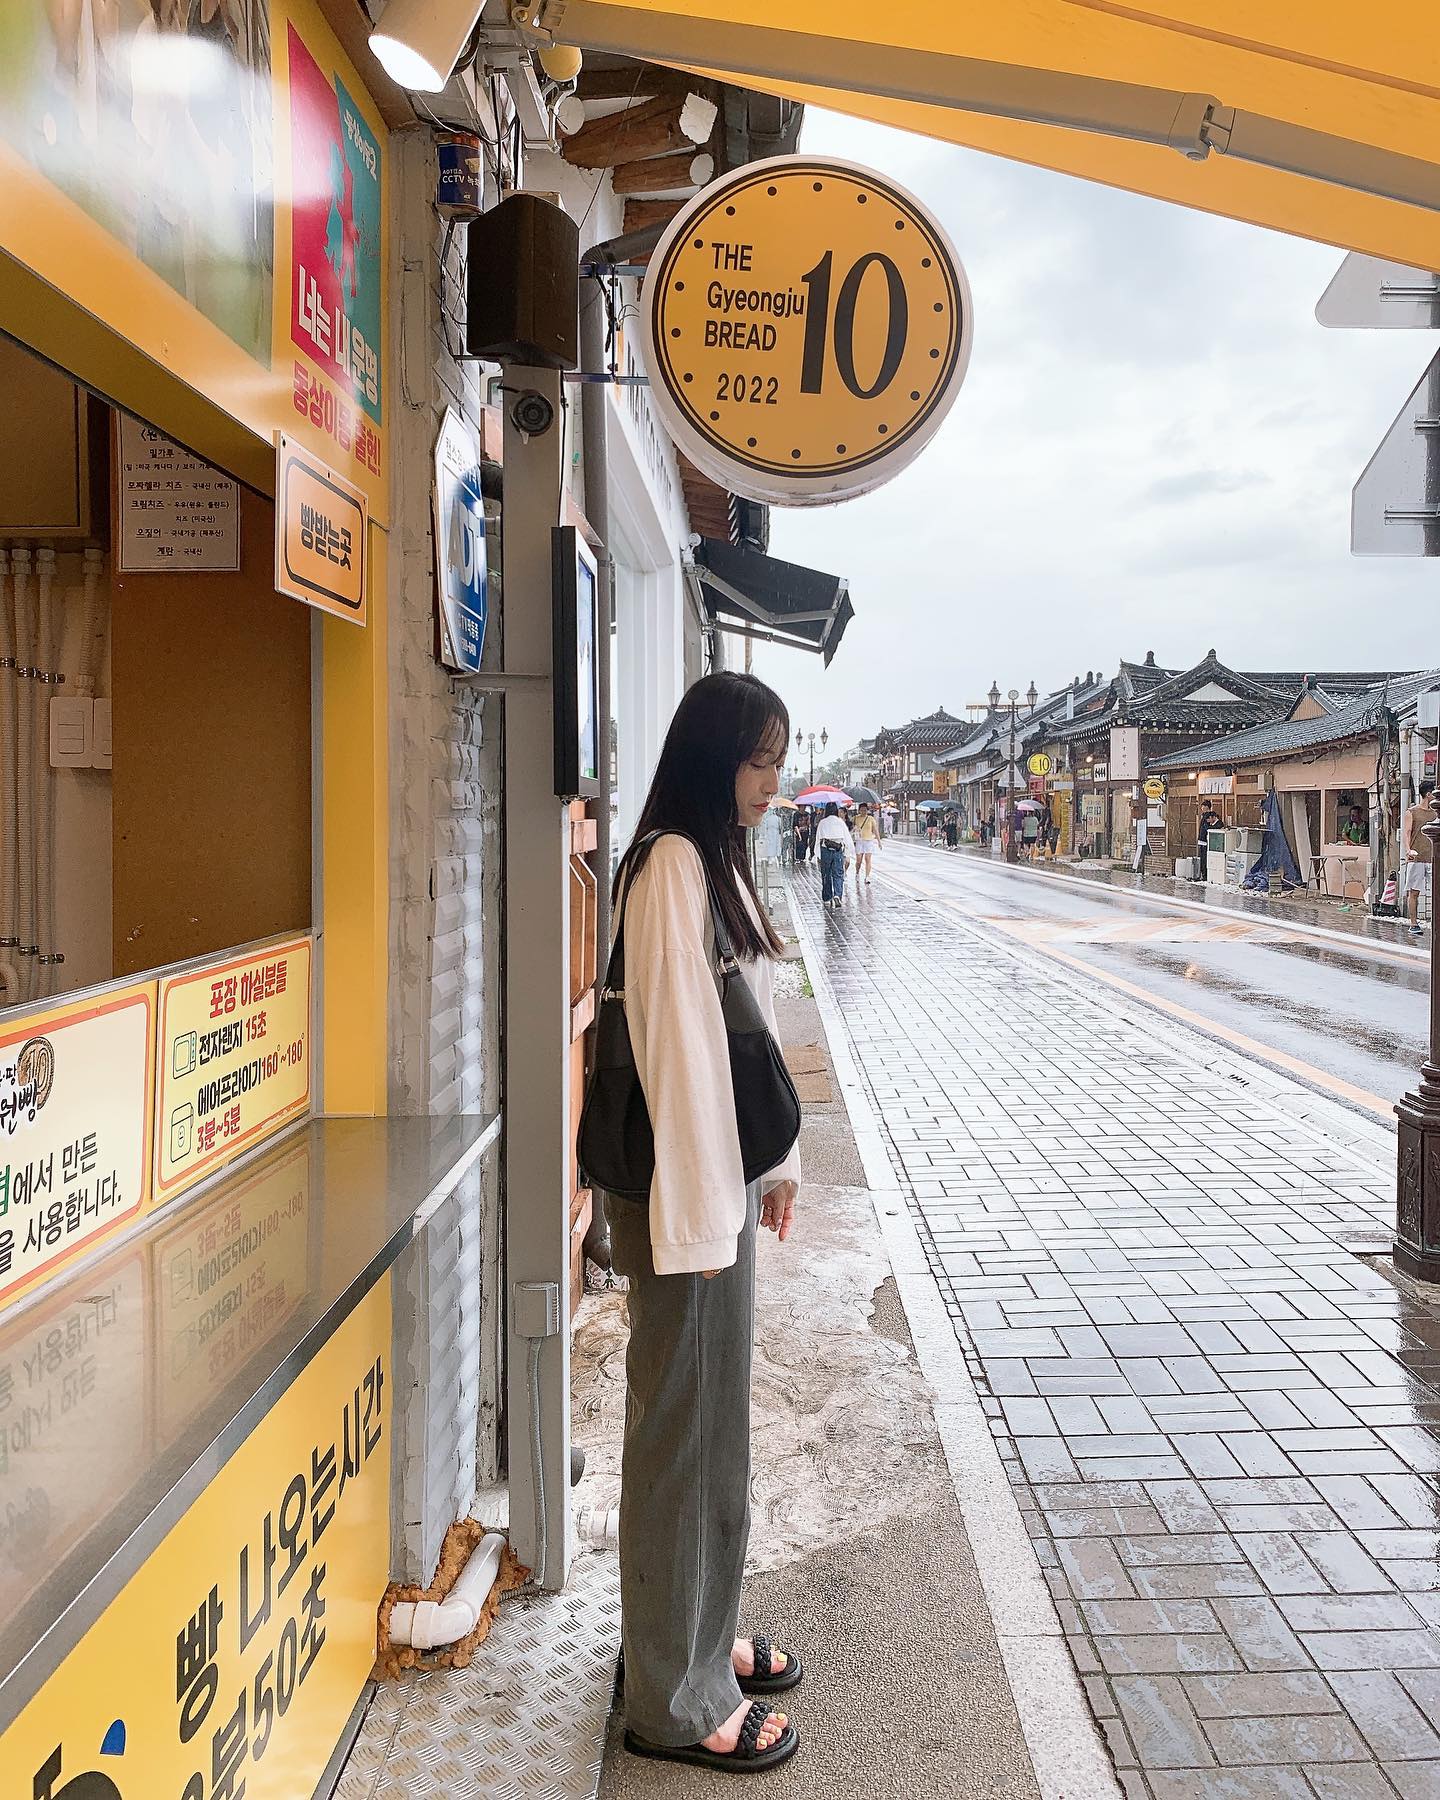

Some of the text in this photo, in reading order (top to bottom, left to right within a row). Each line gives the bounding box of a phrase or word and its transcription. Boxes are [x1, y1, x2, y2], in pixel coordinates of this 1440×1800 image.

[442, 174, 465, 184] CCTV
[711, 242, 753, 272] THE
[299, 264, 331, 357] 너는
[707, 281, 805, 318] Gyeongju
[800, 249, 909, 400] 10
[704, 320, 777, 351] BREAD
[293, 359, 351, 453] 동상이몽
[716, 373, 779, 405] 2022
[136, 528, 161, 537] 오징어
[300, 502, 352, 572] 빵받는곳
[1039, 757, 1050, 771] 10
[210, 960, 288, 1019] 포장 하실분들
[199, 1010, 267, 1066] 전자랜지 15초
[197, 1103, 241, 1154] 3분~5분
[62, 1132, 98, 1185] 만든
[22, 1170, 122, 1254] 사용합니다.
[176, 1583, 224, 1744] 빵
[240, 1355, 384, 1655] 나오는시간
[180, 1561, 327, 1800] 분50초
